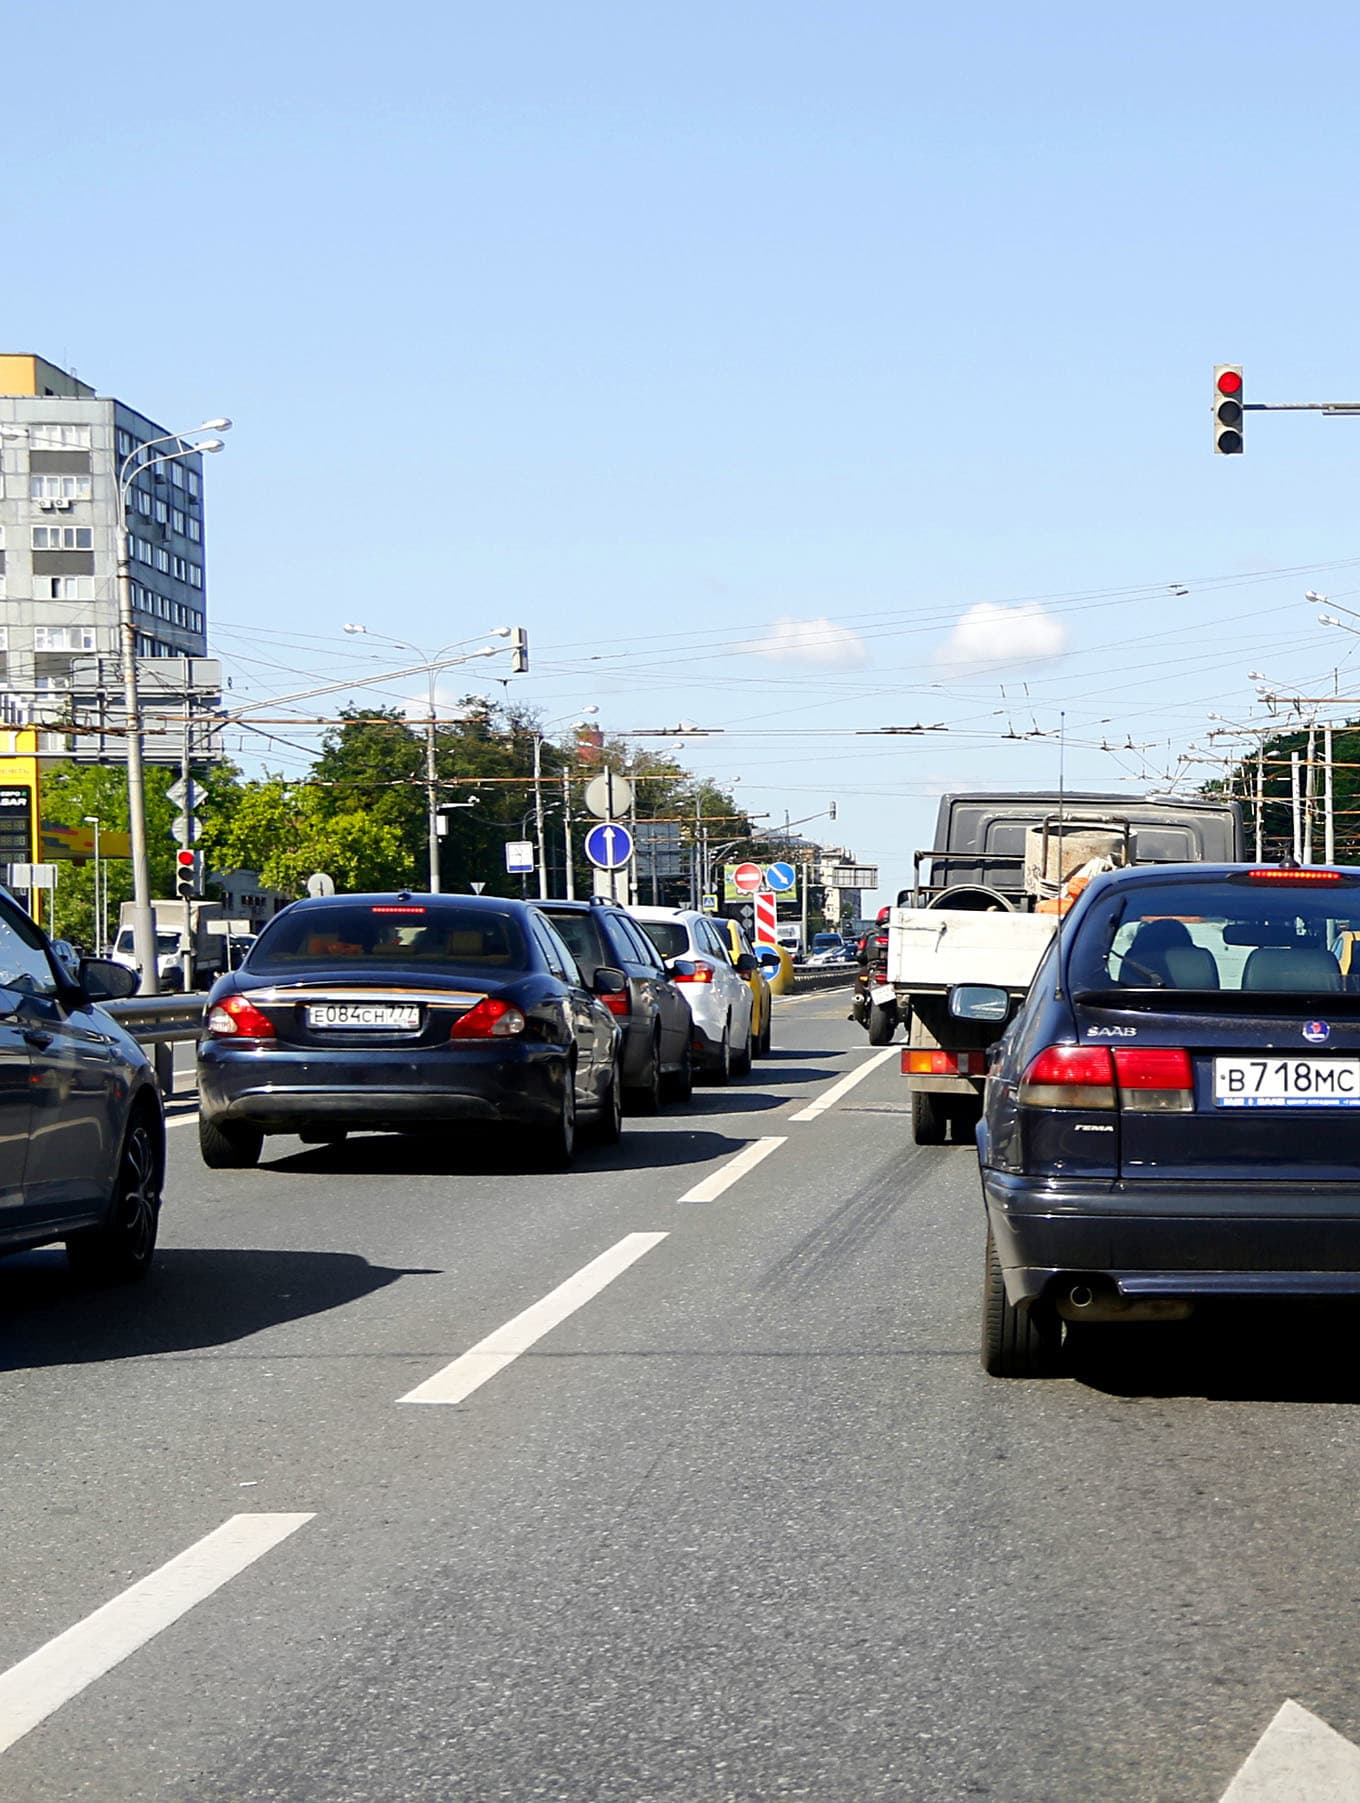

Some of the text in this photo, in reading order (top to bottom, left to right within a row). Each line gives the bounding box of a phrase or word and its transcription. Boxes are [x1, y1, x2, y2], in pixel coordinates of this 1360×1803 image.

[386, 1005, 415, 1019] 777
[1087, 1026, 1137, 1037] SAAB
[1228, 1062, 1354, 1092] В718МС
